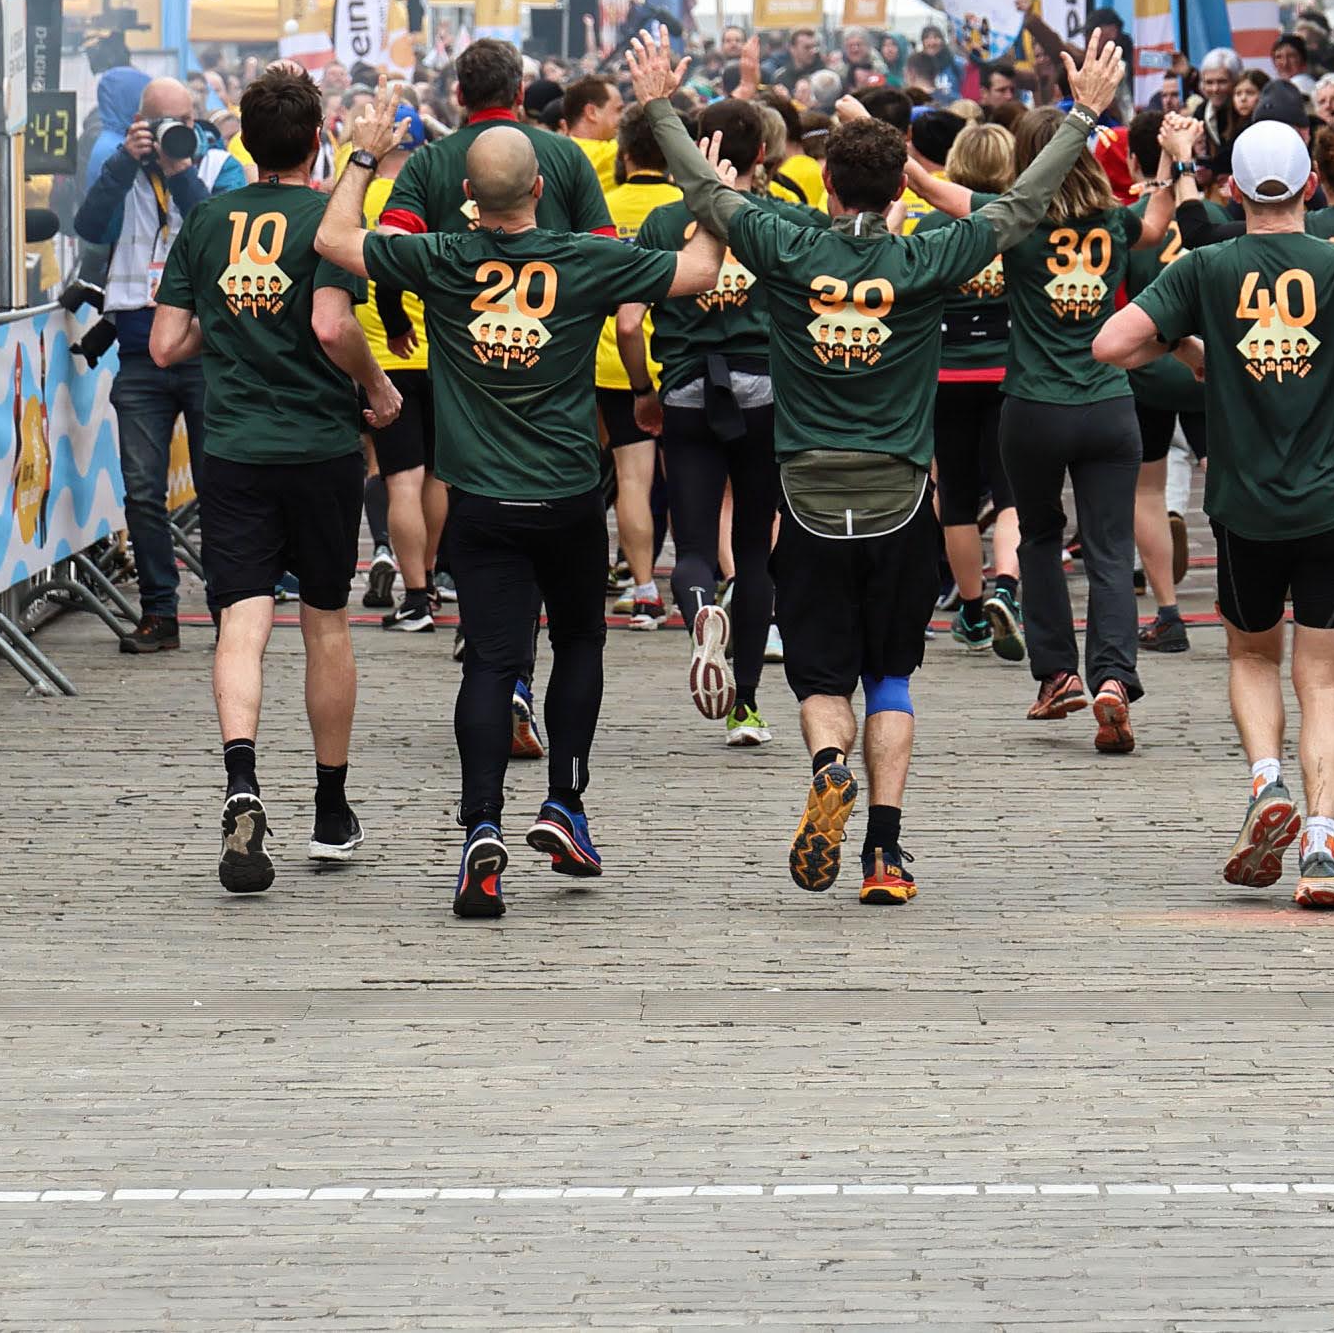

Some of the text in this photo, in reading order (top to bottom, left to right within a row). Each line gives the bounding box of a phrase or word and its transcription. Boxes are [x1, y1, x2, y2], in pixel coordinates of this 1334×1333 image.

[229, 211, 288, 265] 10
[1047, 227, 1112, 276] 30
[471, 260, 558, 319] 20
[809, 274, 894, 318] 30
[1236, 268, 1317, 328] 40
